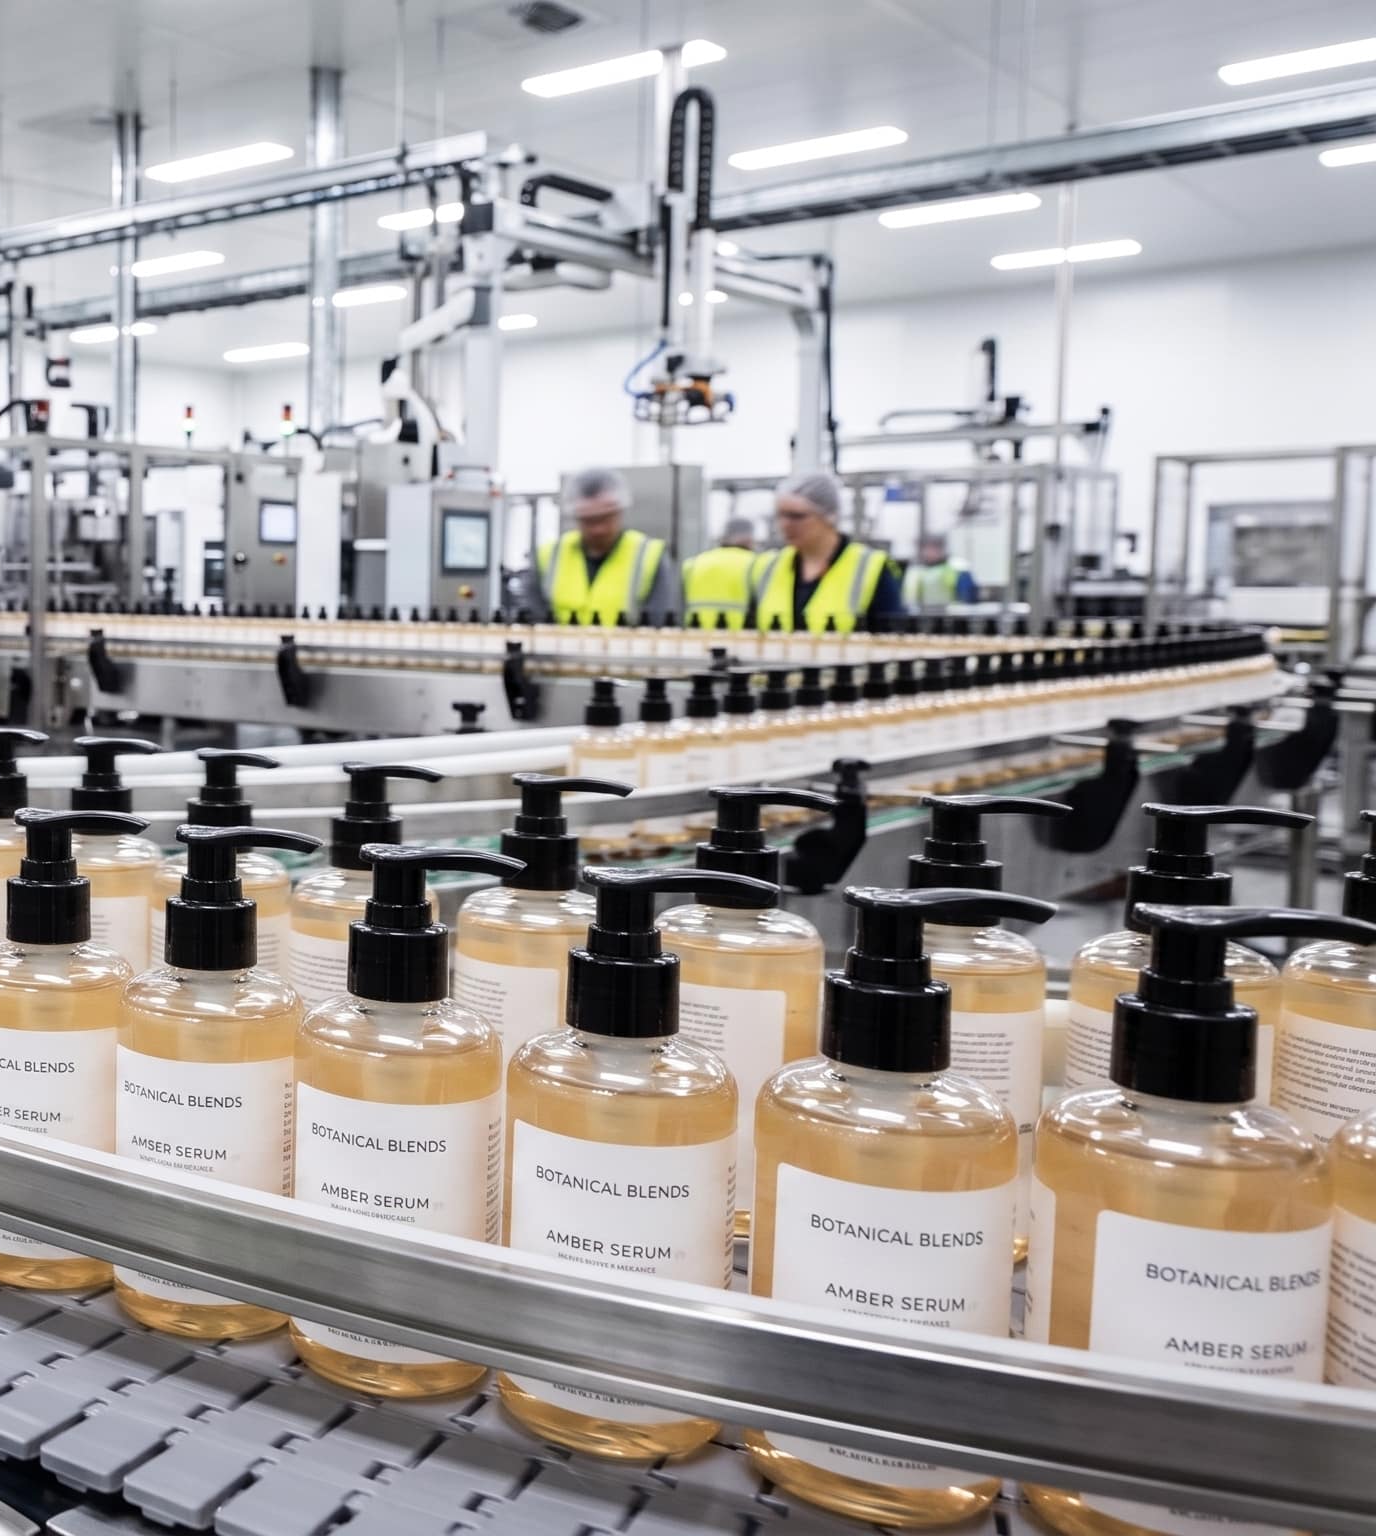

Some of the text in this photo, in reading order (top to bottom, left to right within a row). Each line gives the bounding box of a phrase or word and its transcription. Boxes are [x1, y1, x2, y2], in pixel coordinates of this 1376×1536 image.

[24, 1060, 75, 1073] BLENDS
[124, 1080, 242, 1108] BOTANICAL BLENDS
[14, 1108, 61, 1122] SERUM
[312, 1122, 447, 1153] BOTANICAL BLENDS
[176, 1145, 227, 1160] SERUM
[321, 1183, 429, 1209] AMBER SERUM
[536, 1165, 690, 1199] BOTANICAL BLENDS
[546, 1229, 671, 1260] AMBER SERUM
[811, 1213, 984, 1248] BOTANICAL BLENDS
[1145, 1263, 1264, 1292] BOTANICAL
[824, 1282, 966, 1313] AMBER SERUM
[1165, 1336, 1308, 1360] AMBER SERUM
